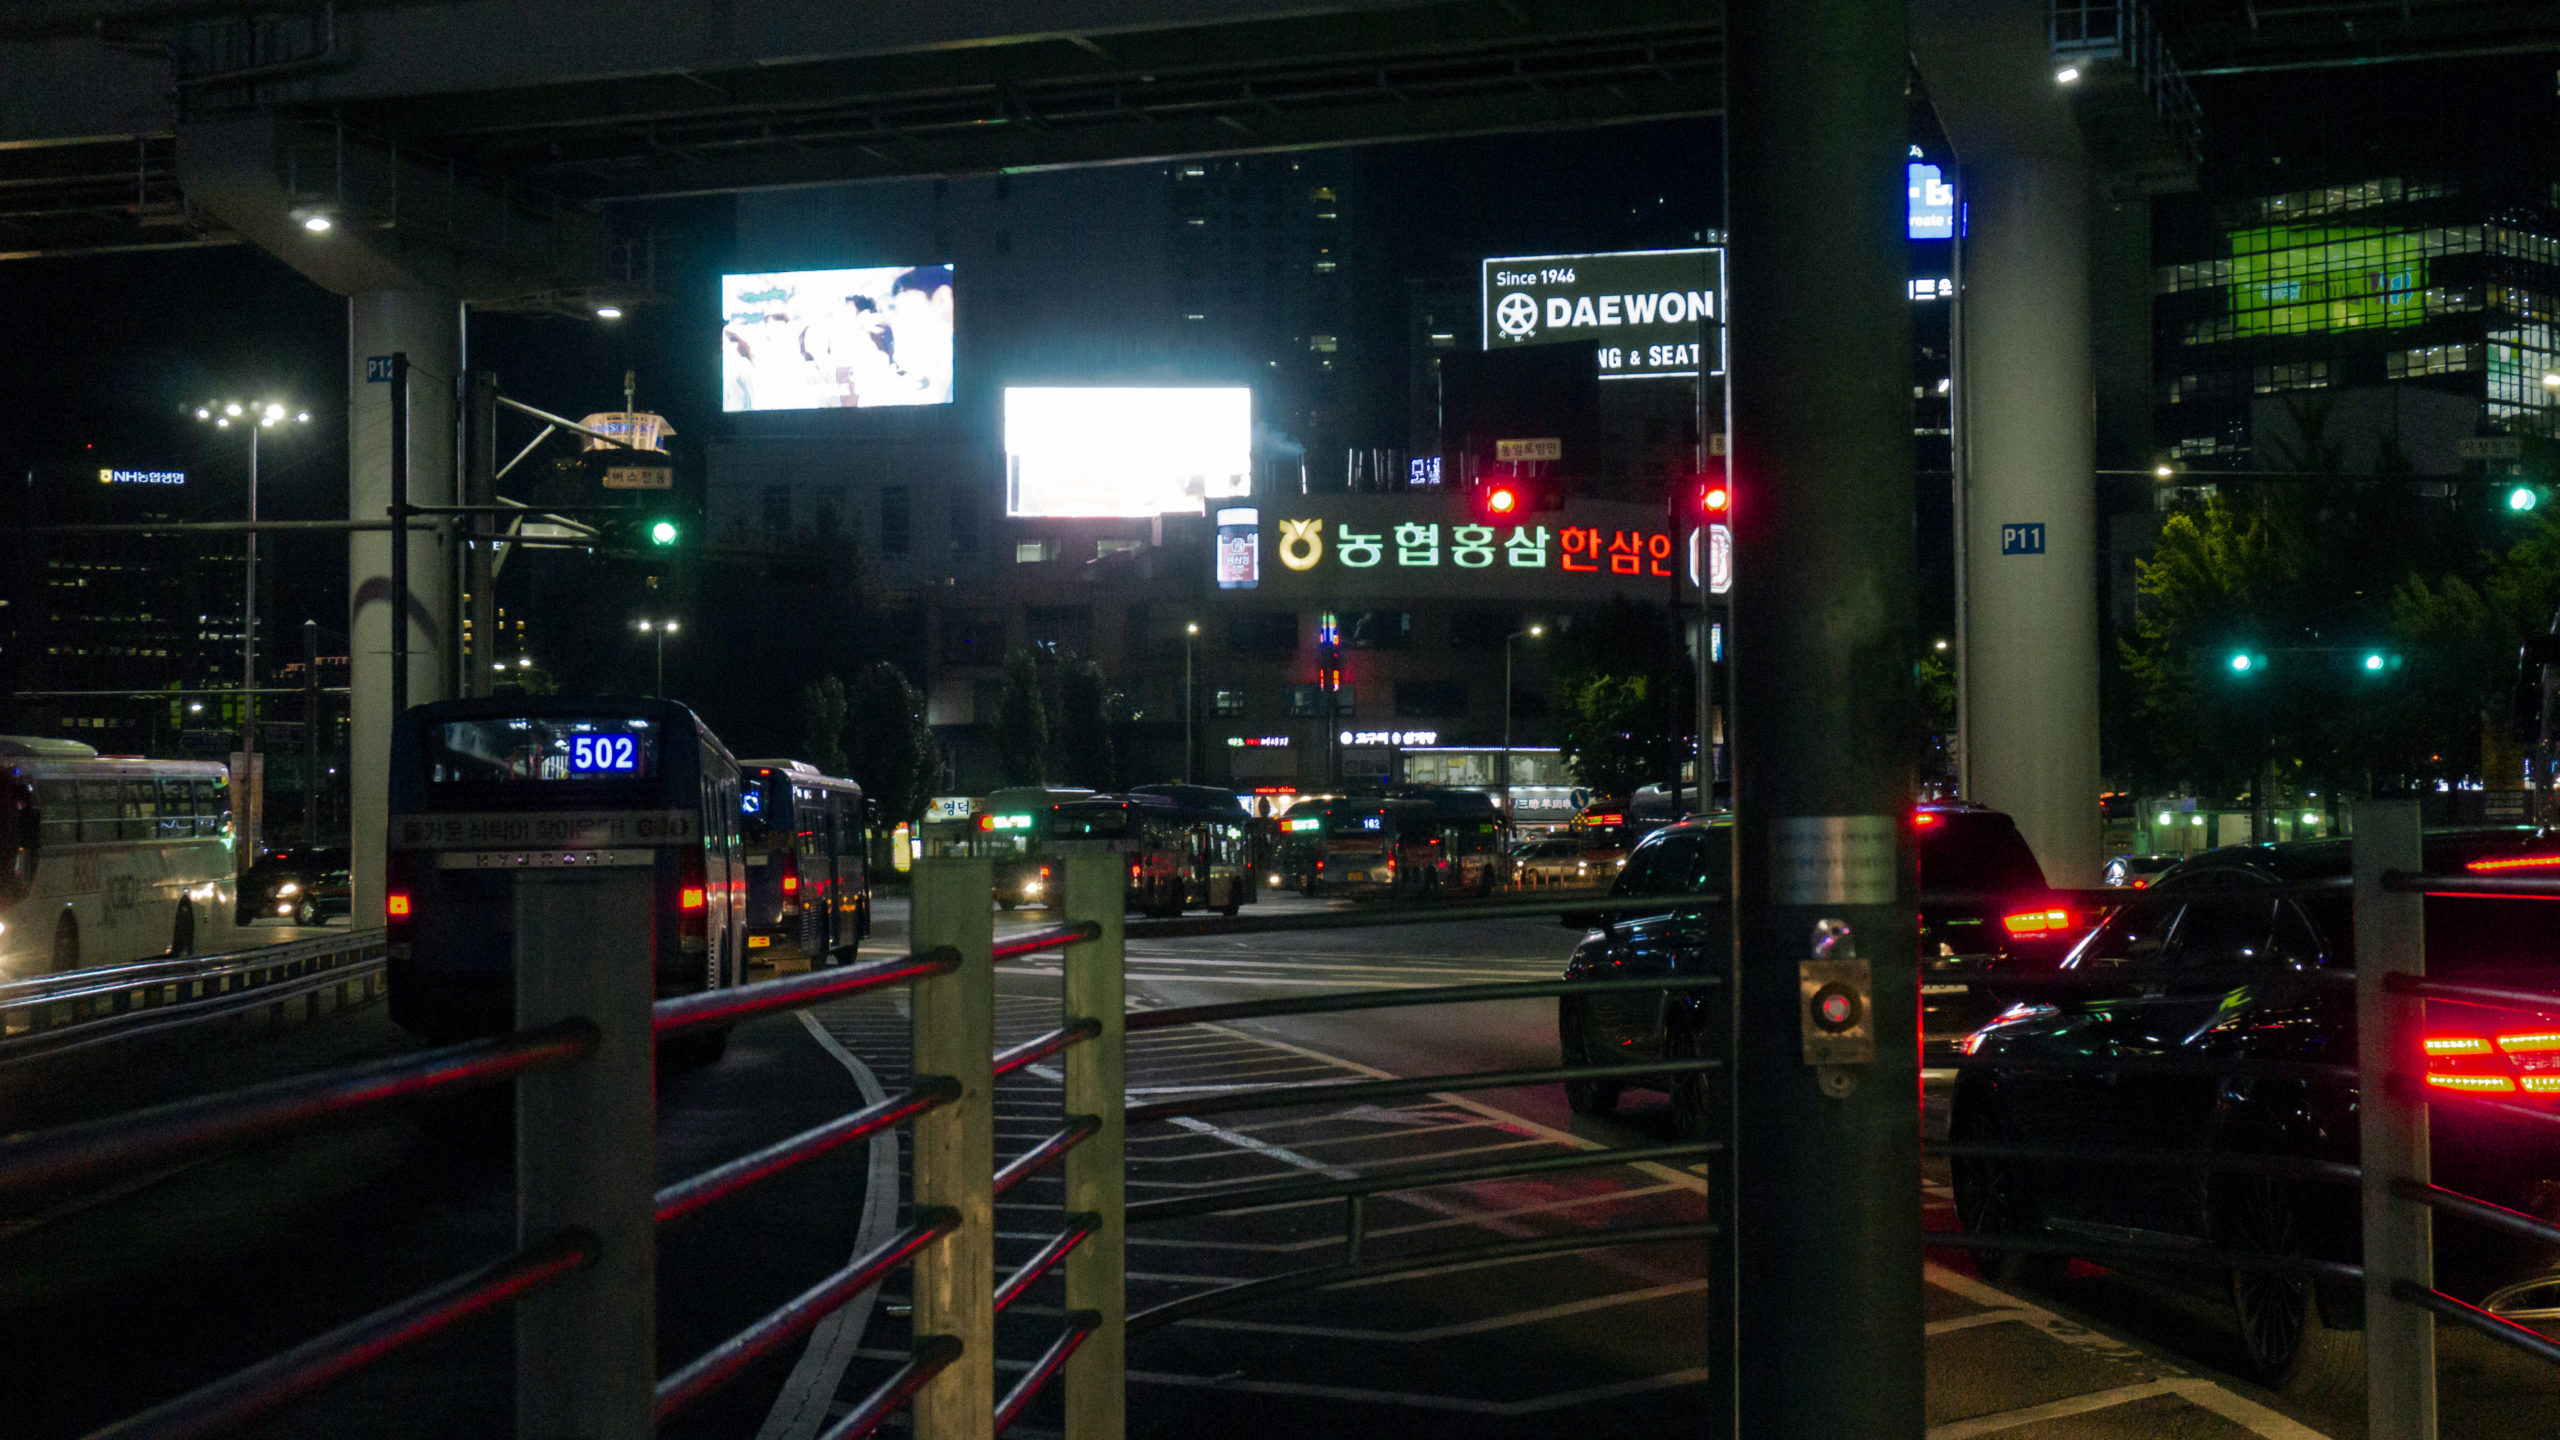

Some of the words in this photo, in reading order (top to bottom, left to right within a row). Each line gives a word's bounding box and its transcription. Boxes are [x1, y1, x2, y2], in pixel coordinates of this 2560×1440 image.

[1497, 272, 1536, 286] Since
[1540, 269, 1576, 285] 1946
[1546, 290, 1714, 328] DAEWON
[1629, 350, 1641, 365] &
[2004, 528, 2040, 549] P11
[575, 737, 633, 769] 502
[1363, 818, 1380, 829] 162
